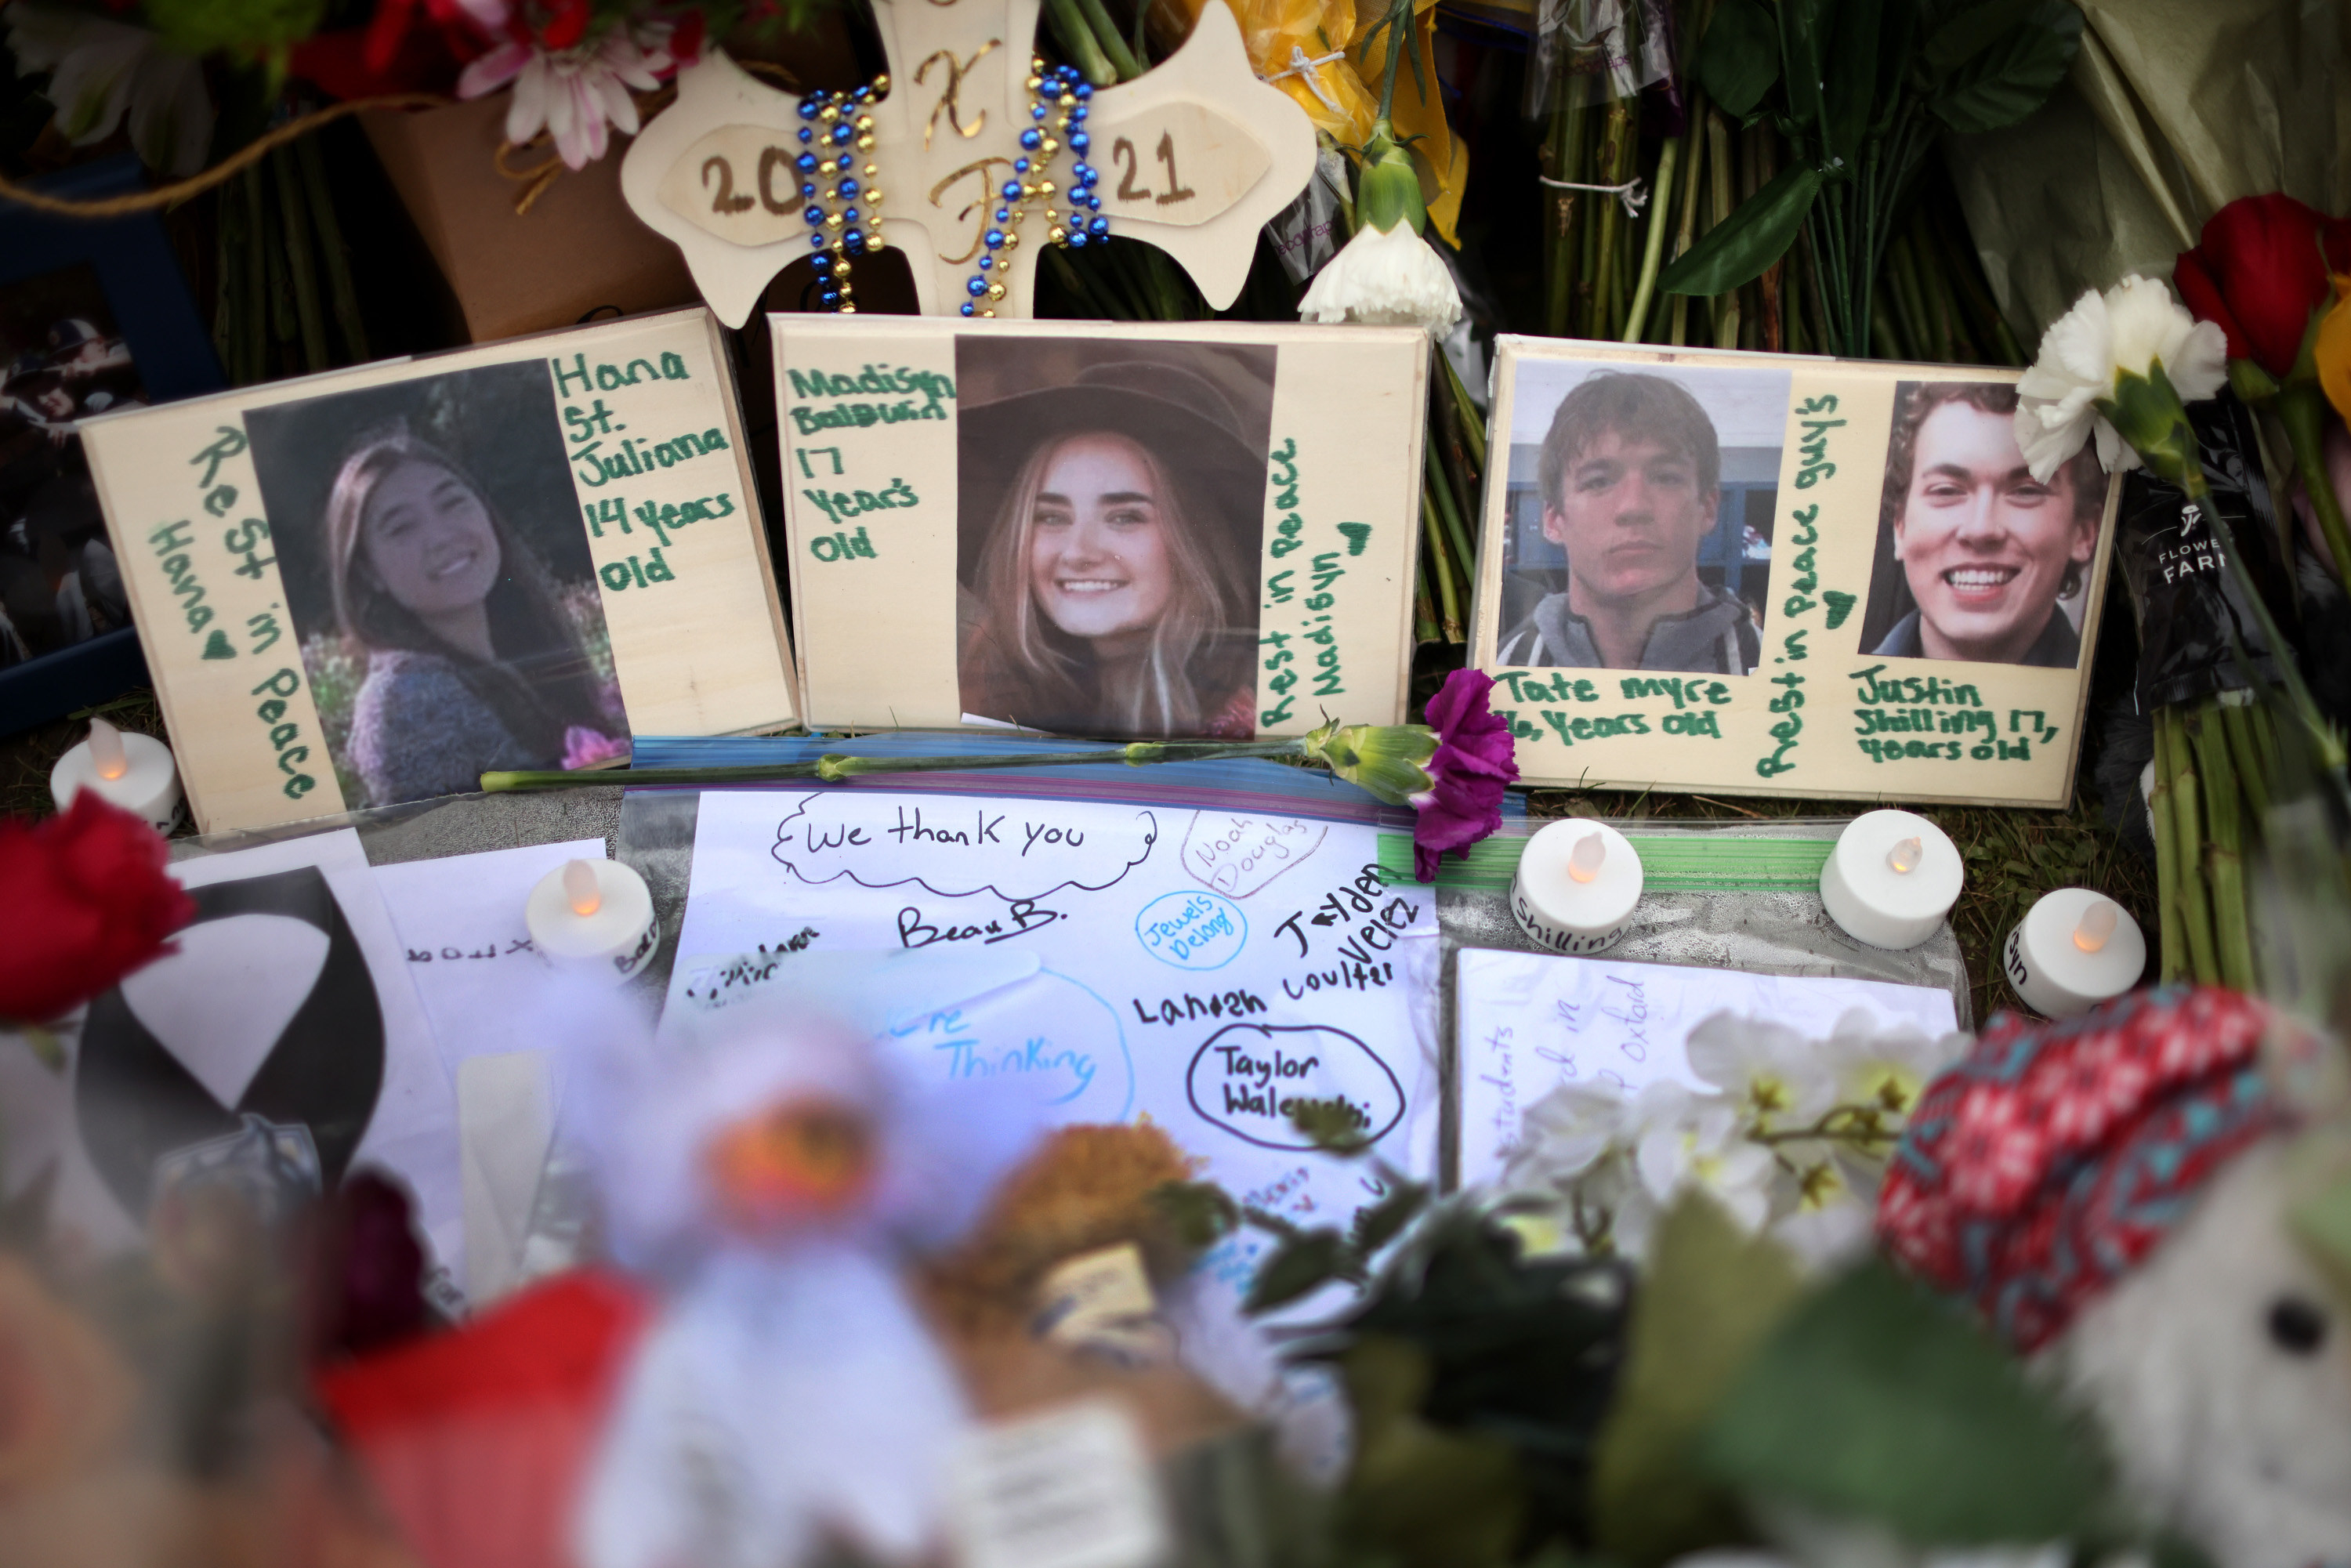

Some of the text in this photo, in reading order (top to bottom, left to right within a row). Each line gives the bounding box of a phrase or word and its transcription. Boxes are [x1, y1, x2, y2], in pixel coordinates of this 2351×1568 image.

[701, 129, 1196, 216] 20 21
[552, 352, 691, 398] Hana
[563, 399, 627, 444] St.
[571, 428, 730, 487] Juliana
[795, 447, 844, 479] 17
[189, 425, 277, 580] Rest
[247, 602, 283, 655] in
[585, 493, 736, 547] 14 years
[148, 519, 216, 635] Hana
[2159, 538, 2221, 565] FLOWE
[1263, 570, 1295, 608] in
[1301, 551, 1346, 696] Madisyn
[1773, 628, 1809, 664] in
[1259, 630, 1299, 728] Rest
[1492, 670, 1599, 703] Tate
[1848, 664, 1983, 708] Justin
[1756, 672, 1806, 778] Rest
[2009, 708, 2059, 744] 17,
[888, 806, 1005, 847] thank
[1025, 821, 1085, 857] you
[1196, 817, 1253, 868] Noah
[1210, 819, 1307, 893] Douglas
[1144, 895, 1212, 947] Jewels
[1273, 863, 1420, 965] Jayden Velez
[933, 1035, 1097, 1106] Thinking
[1214, 1045, 1320, 1088] Taylor
